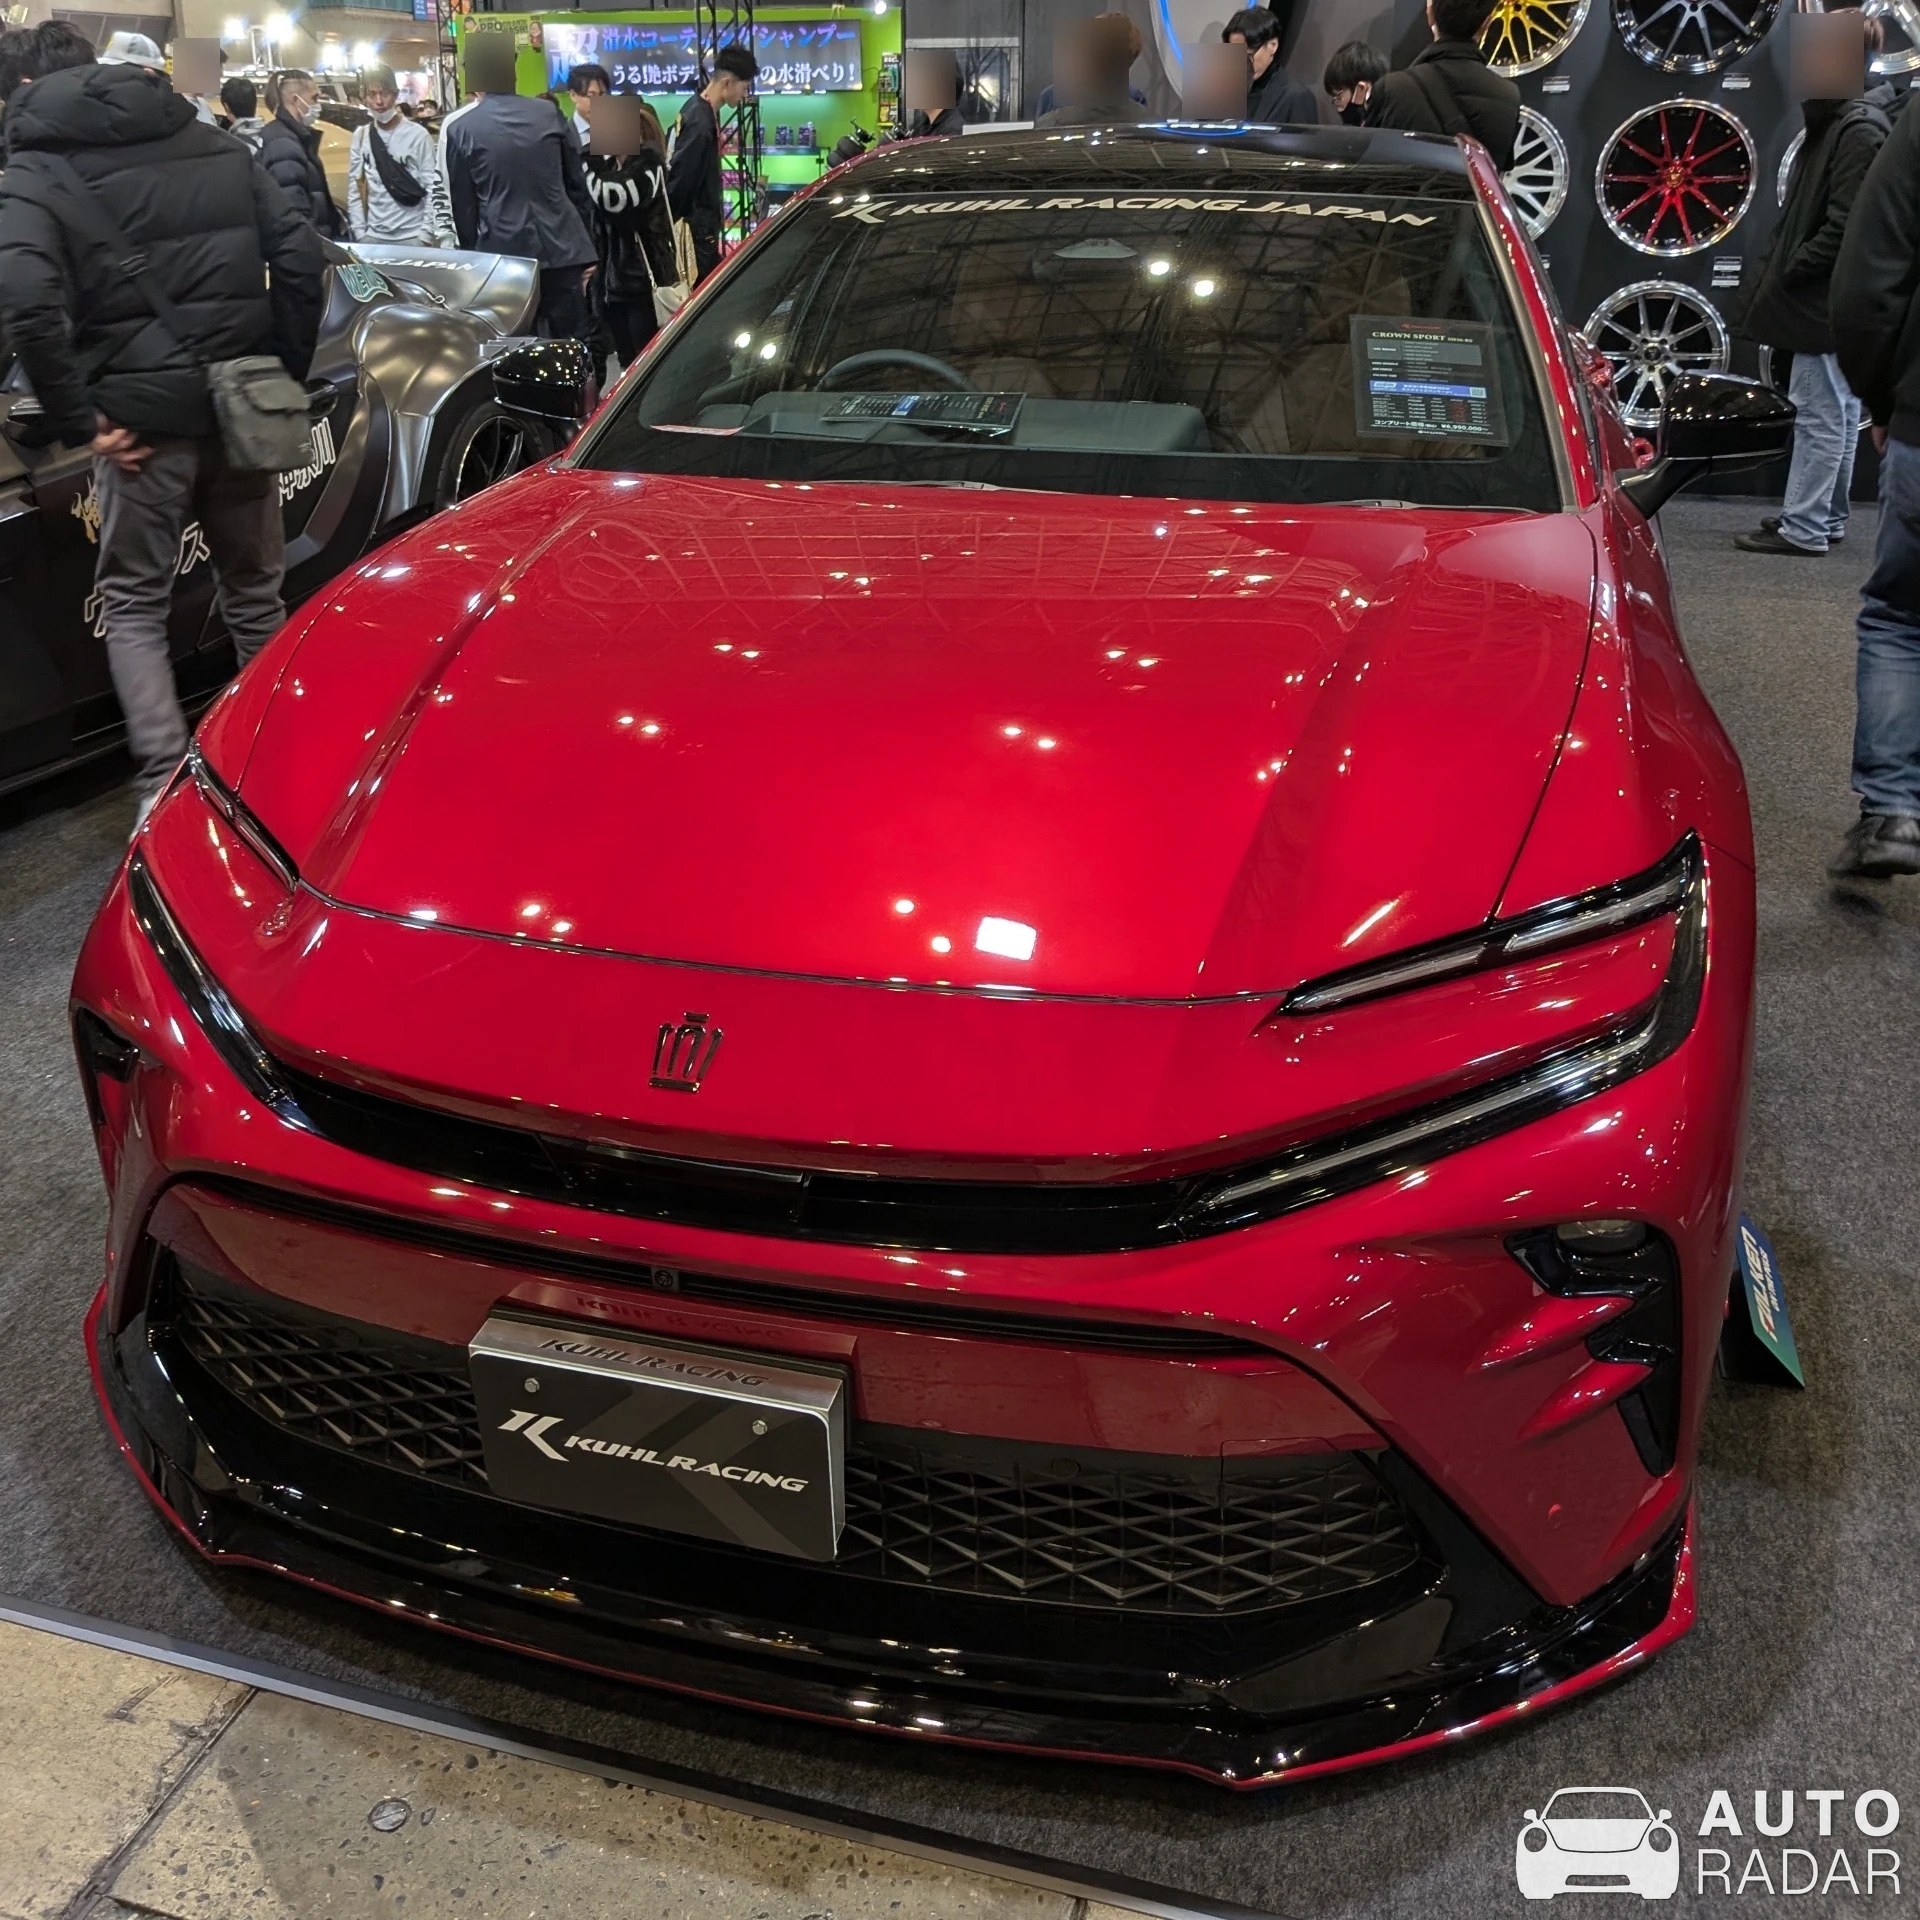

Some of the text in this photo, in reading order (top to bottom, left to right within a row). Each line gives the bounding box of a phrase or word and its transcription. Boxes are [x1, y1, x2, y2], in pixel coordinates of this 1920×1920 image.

[889, 199, 1034, 217] KUHL
[1035, 197, 1248, 211] RACING
[1236, 201, 1437, 227] JAPAN
[1371, 331, 1411, 339] CROWN
[1412, 333, 1446, 341] SPORT
[537, 1339, 770, 1387] KUHL RACING
[564, 1435, 665, 1466] KUHL
[666, 1455, 809, 1492] RACING
